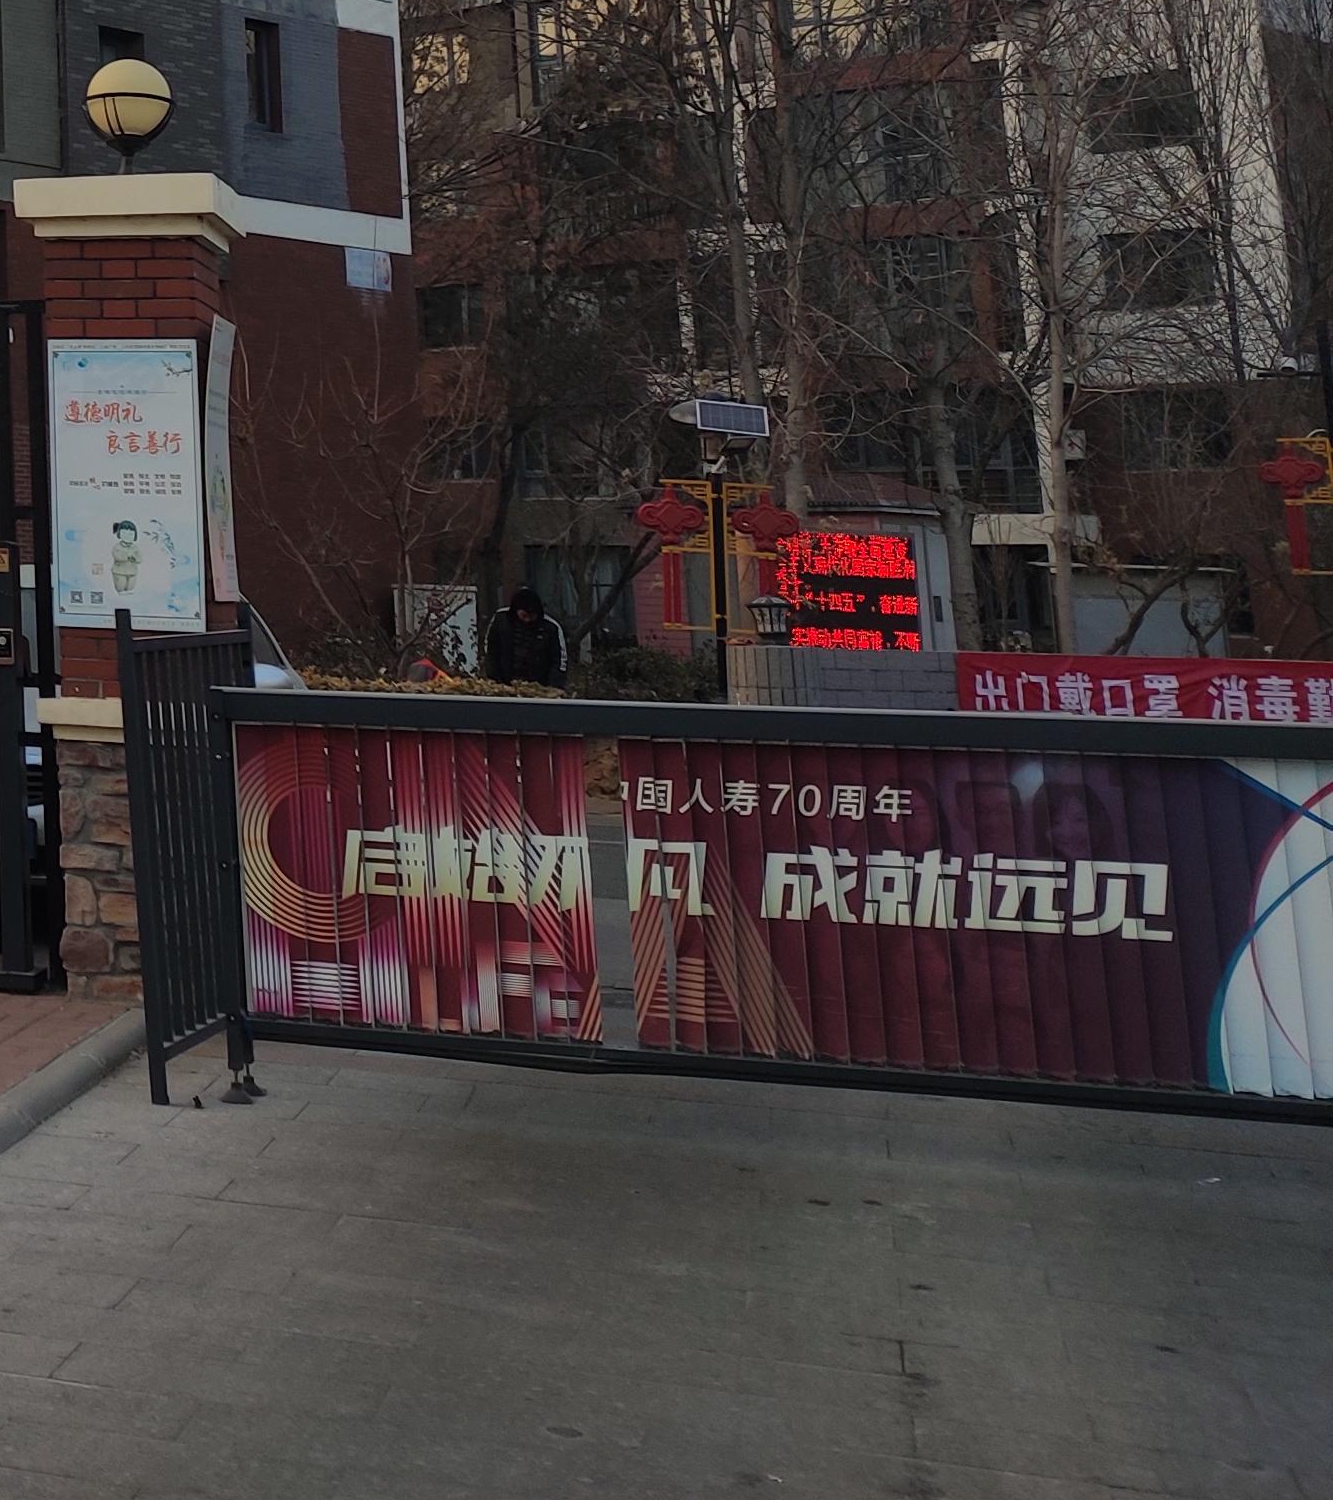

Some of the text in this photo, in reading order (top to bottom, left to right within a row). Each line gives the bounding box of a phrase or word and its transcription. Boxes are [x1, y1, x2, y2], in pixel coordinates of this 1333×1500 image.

[64, 401, 143, 424] 遵德明礼
[105, 430, 183, 455] 良言善行
[974, 670, 1184, 718] 出门戴口罩
[760, 844, 1174, 943] 成就远见
